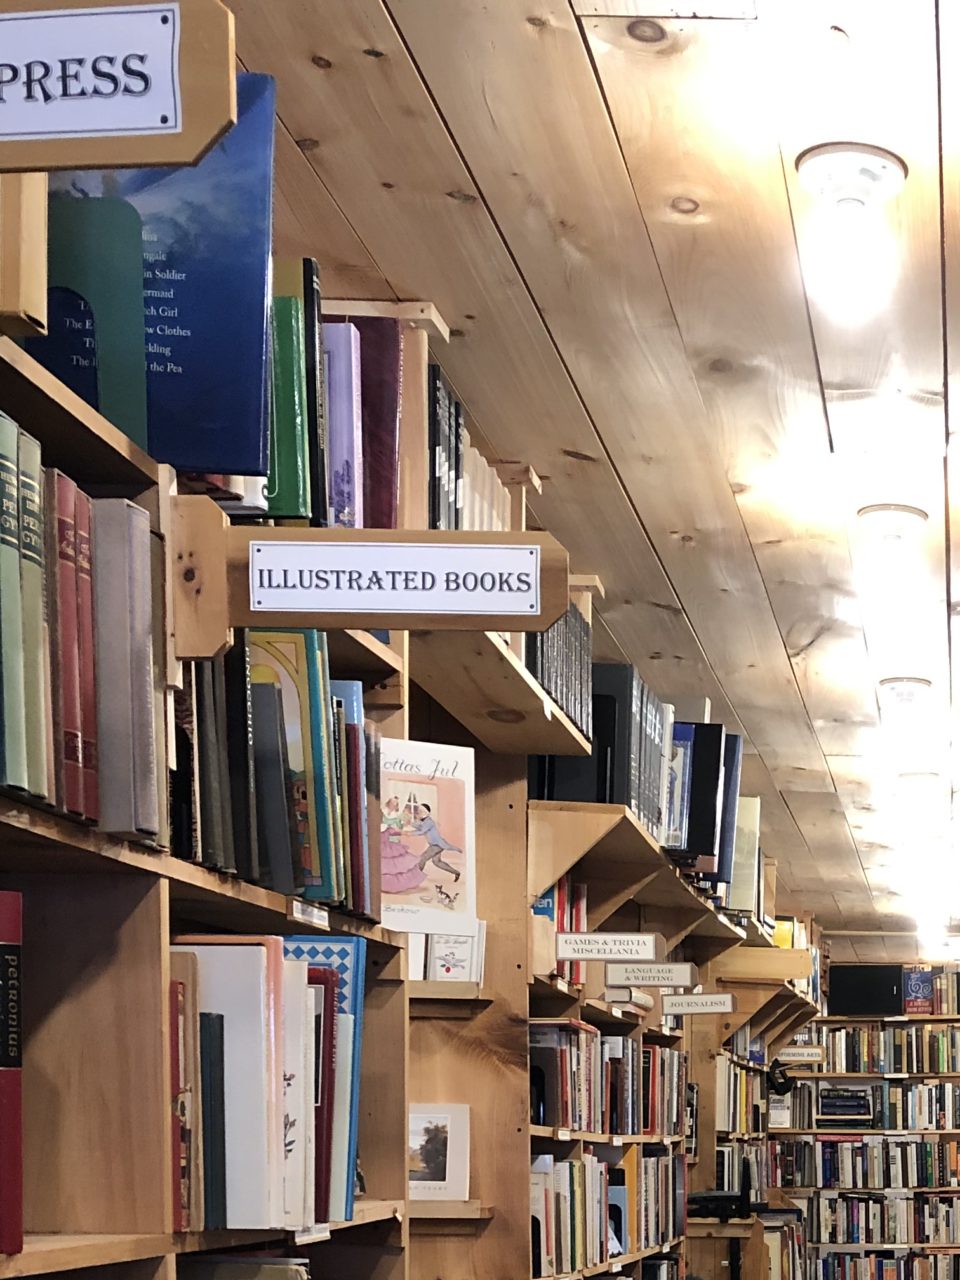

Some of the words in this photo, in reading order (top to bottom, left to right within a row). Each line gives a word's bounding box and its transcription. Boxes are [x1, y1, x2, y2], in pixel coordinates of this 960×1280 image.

[0, 52, 152, 104] PRESS
[155, 269, 186, 281] Soldier
[143, 289, 174, 299] ermaid
[159, 307, 178, 318] Girl
[64, 317, 82, 329] The
[157, 325, 191, 337] Clothes
[71, 355, 89, 367] The
[150, 362, 164, 373] the
[167, 363, 182, 374] Pea
[257, 565, 437, 592] ILLUSTRATED
[444, 569, 532, 594] BOOKS
[427, 759, 459, 780] Jul
[613, 939, 647, 947] TRIVIA
